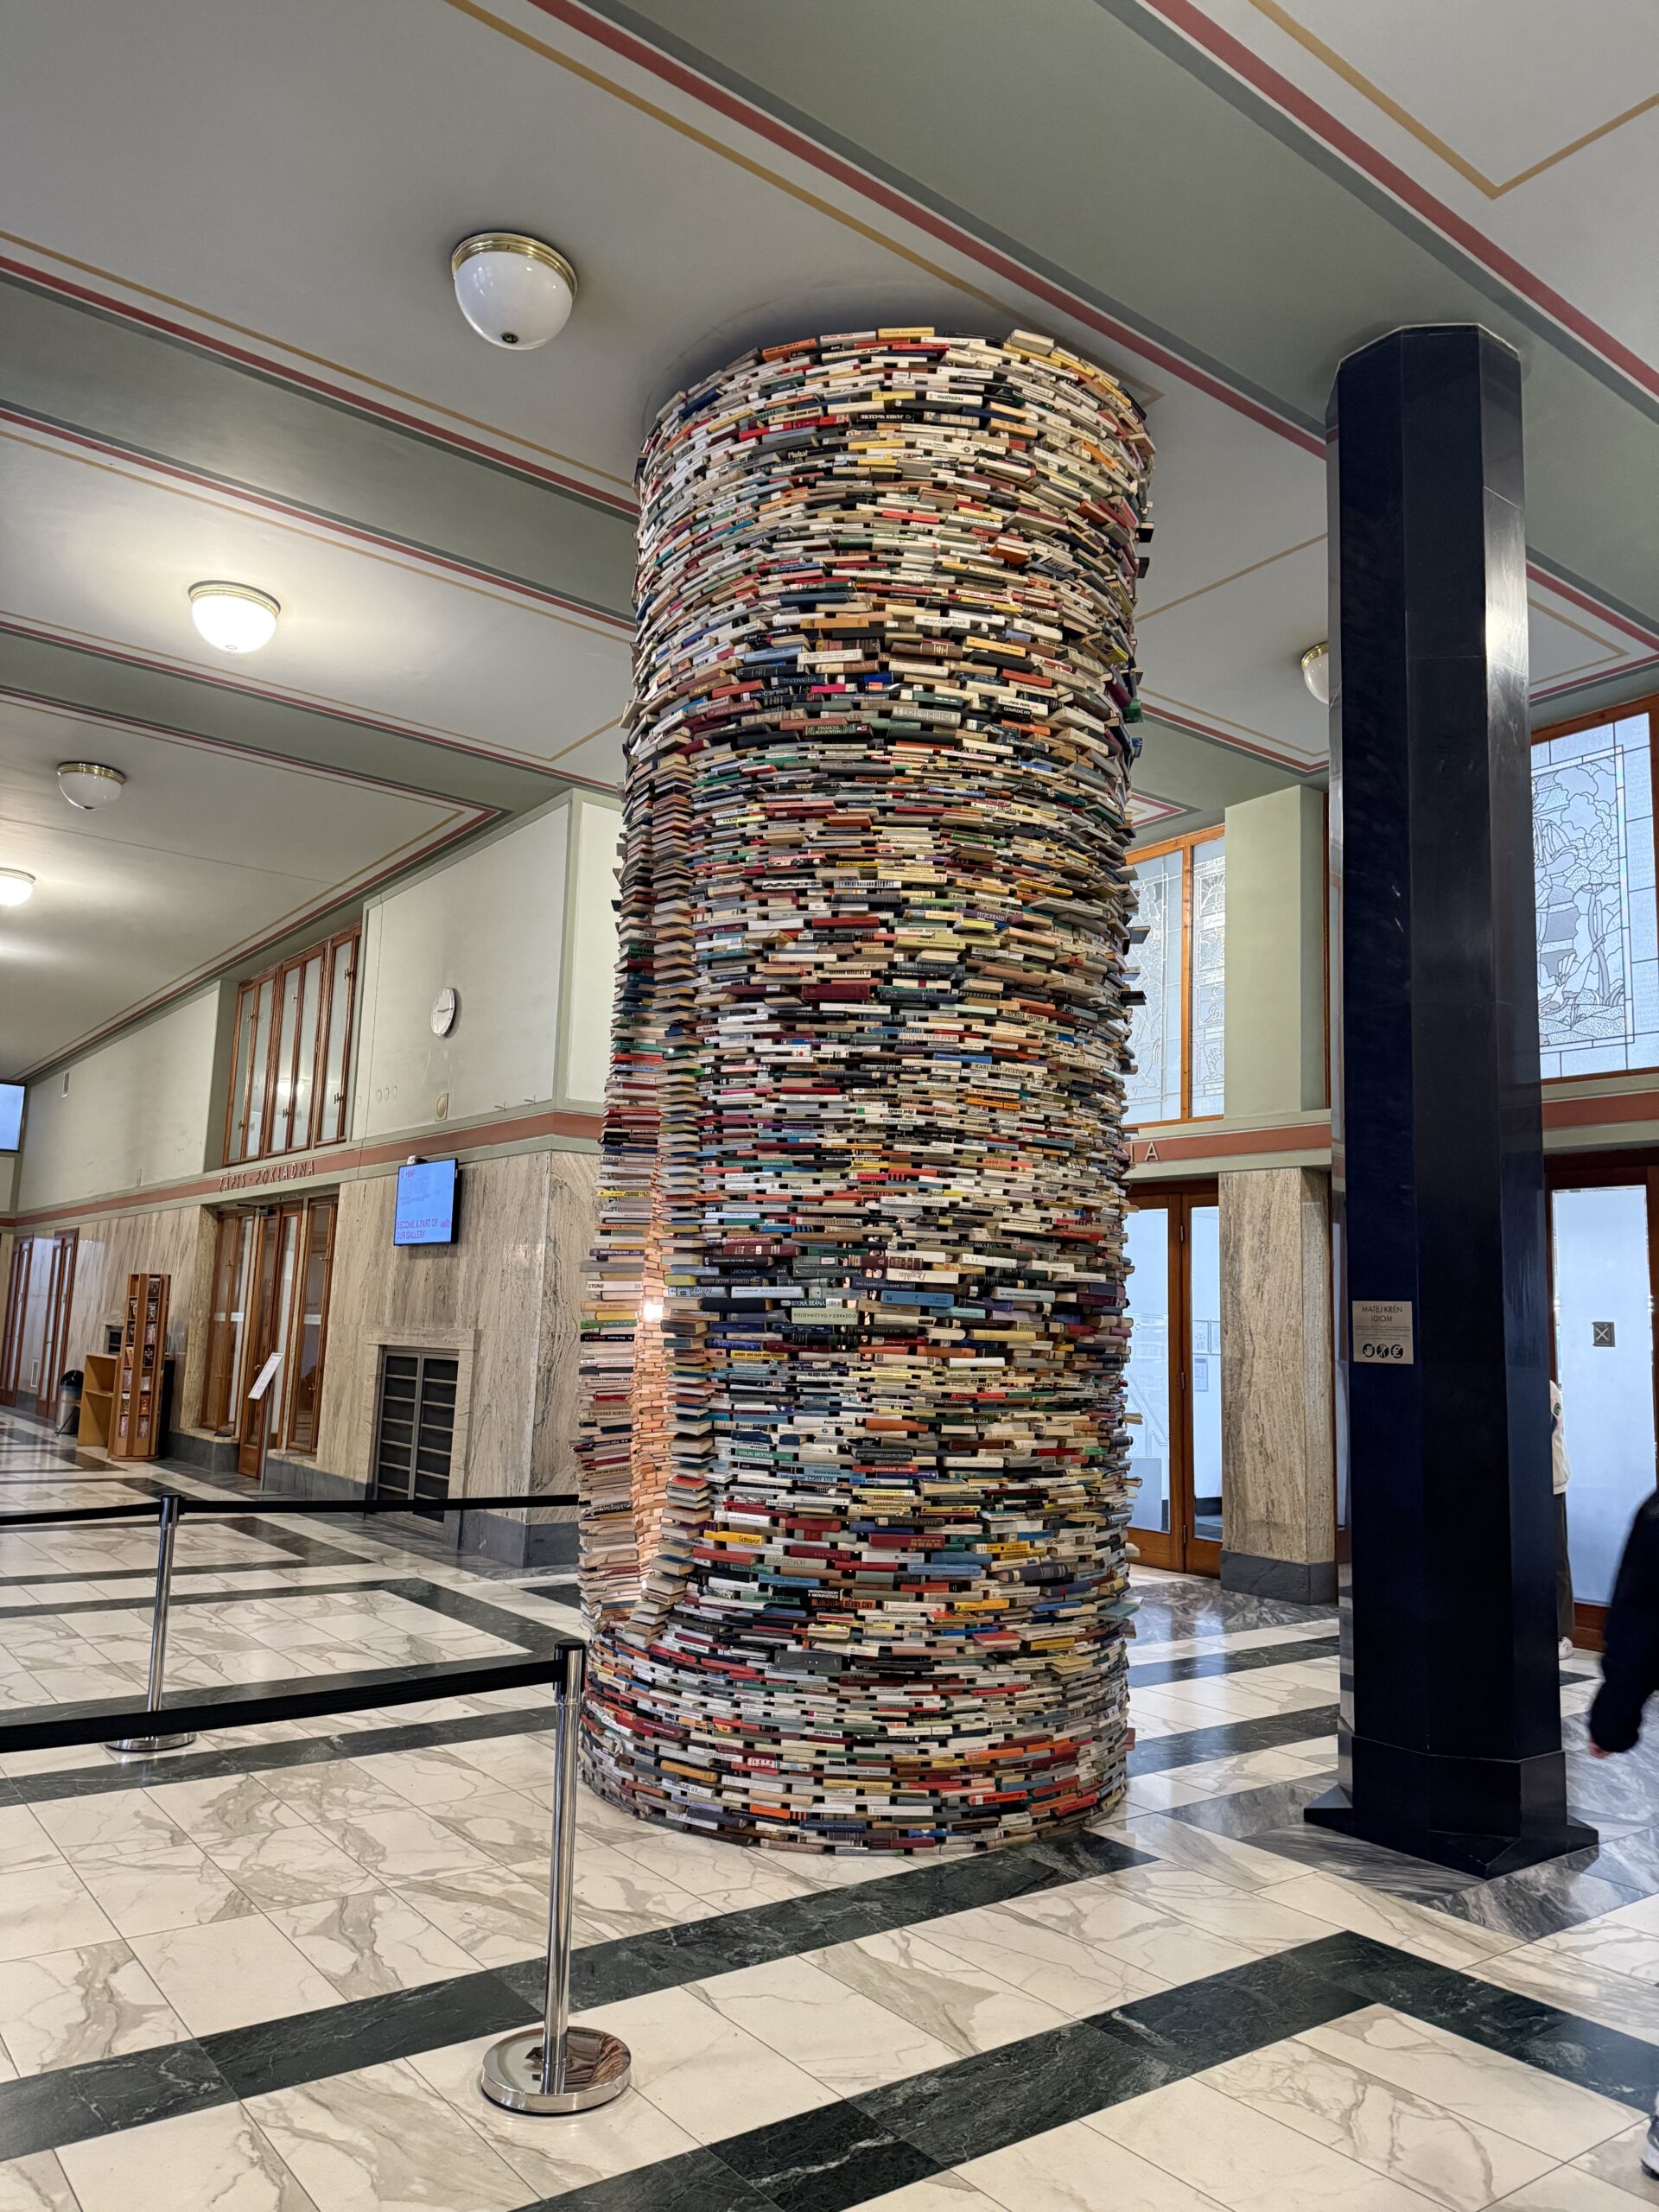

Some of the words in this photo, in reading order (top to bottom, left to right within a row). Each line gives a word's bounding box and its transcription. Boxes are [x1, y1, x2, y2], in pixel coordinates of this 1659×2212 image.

[397, 1219, 415, 1229] BECOME
[420, 1218, 430, 1227] PART
[431, 1218, 438, 1227] OF
[397, 1230, 405, 1240] OUR
[406, 1230, 426, 1239] GALLERY
